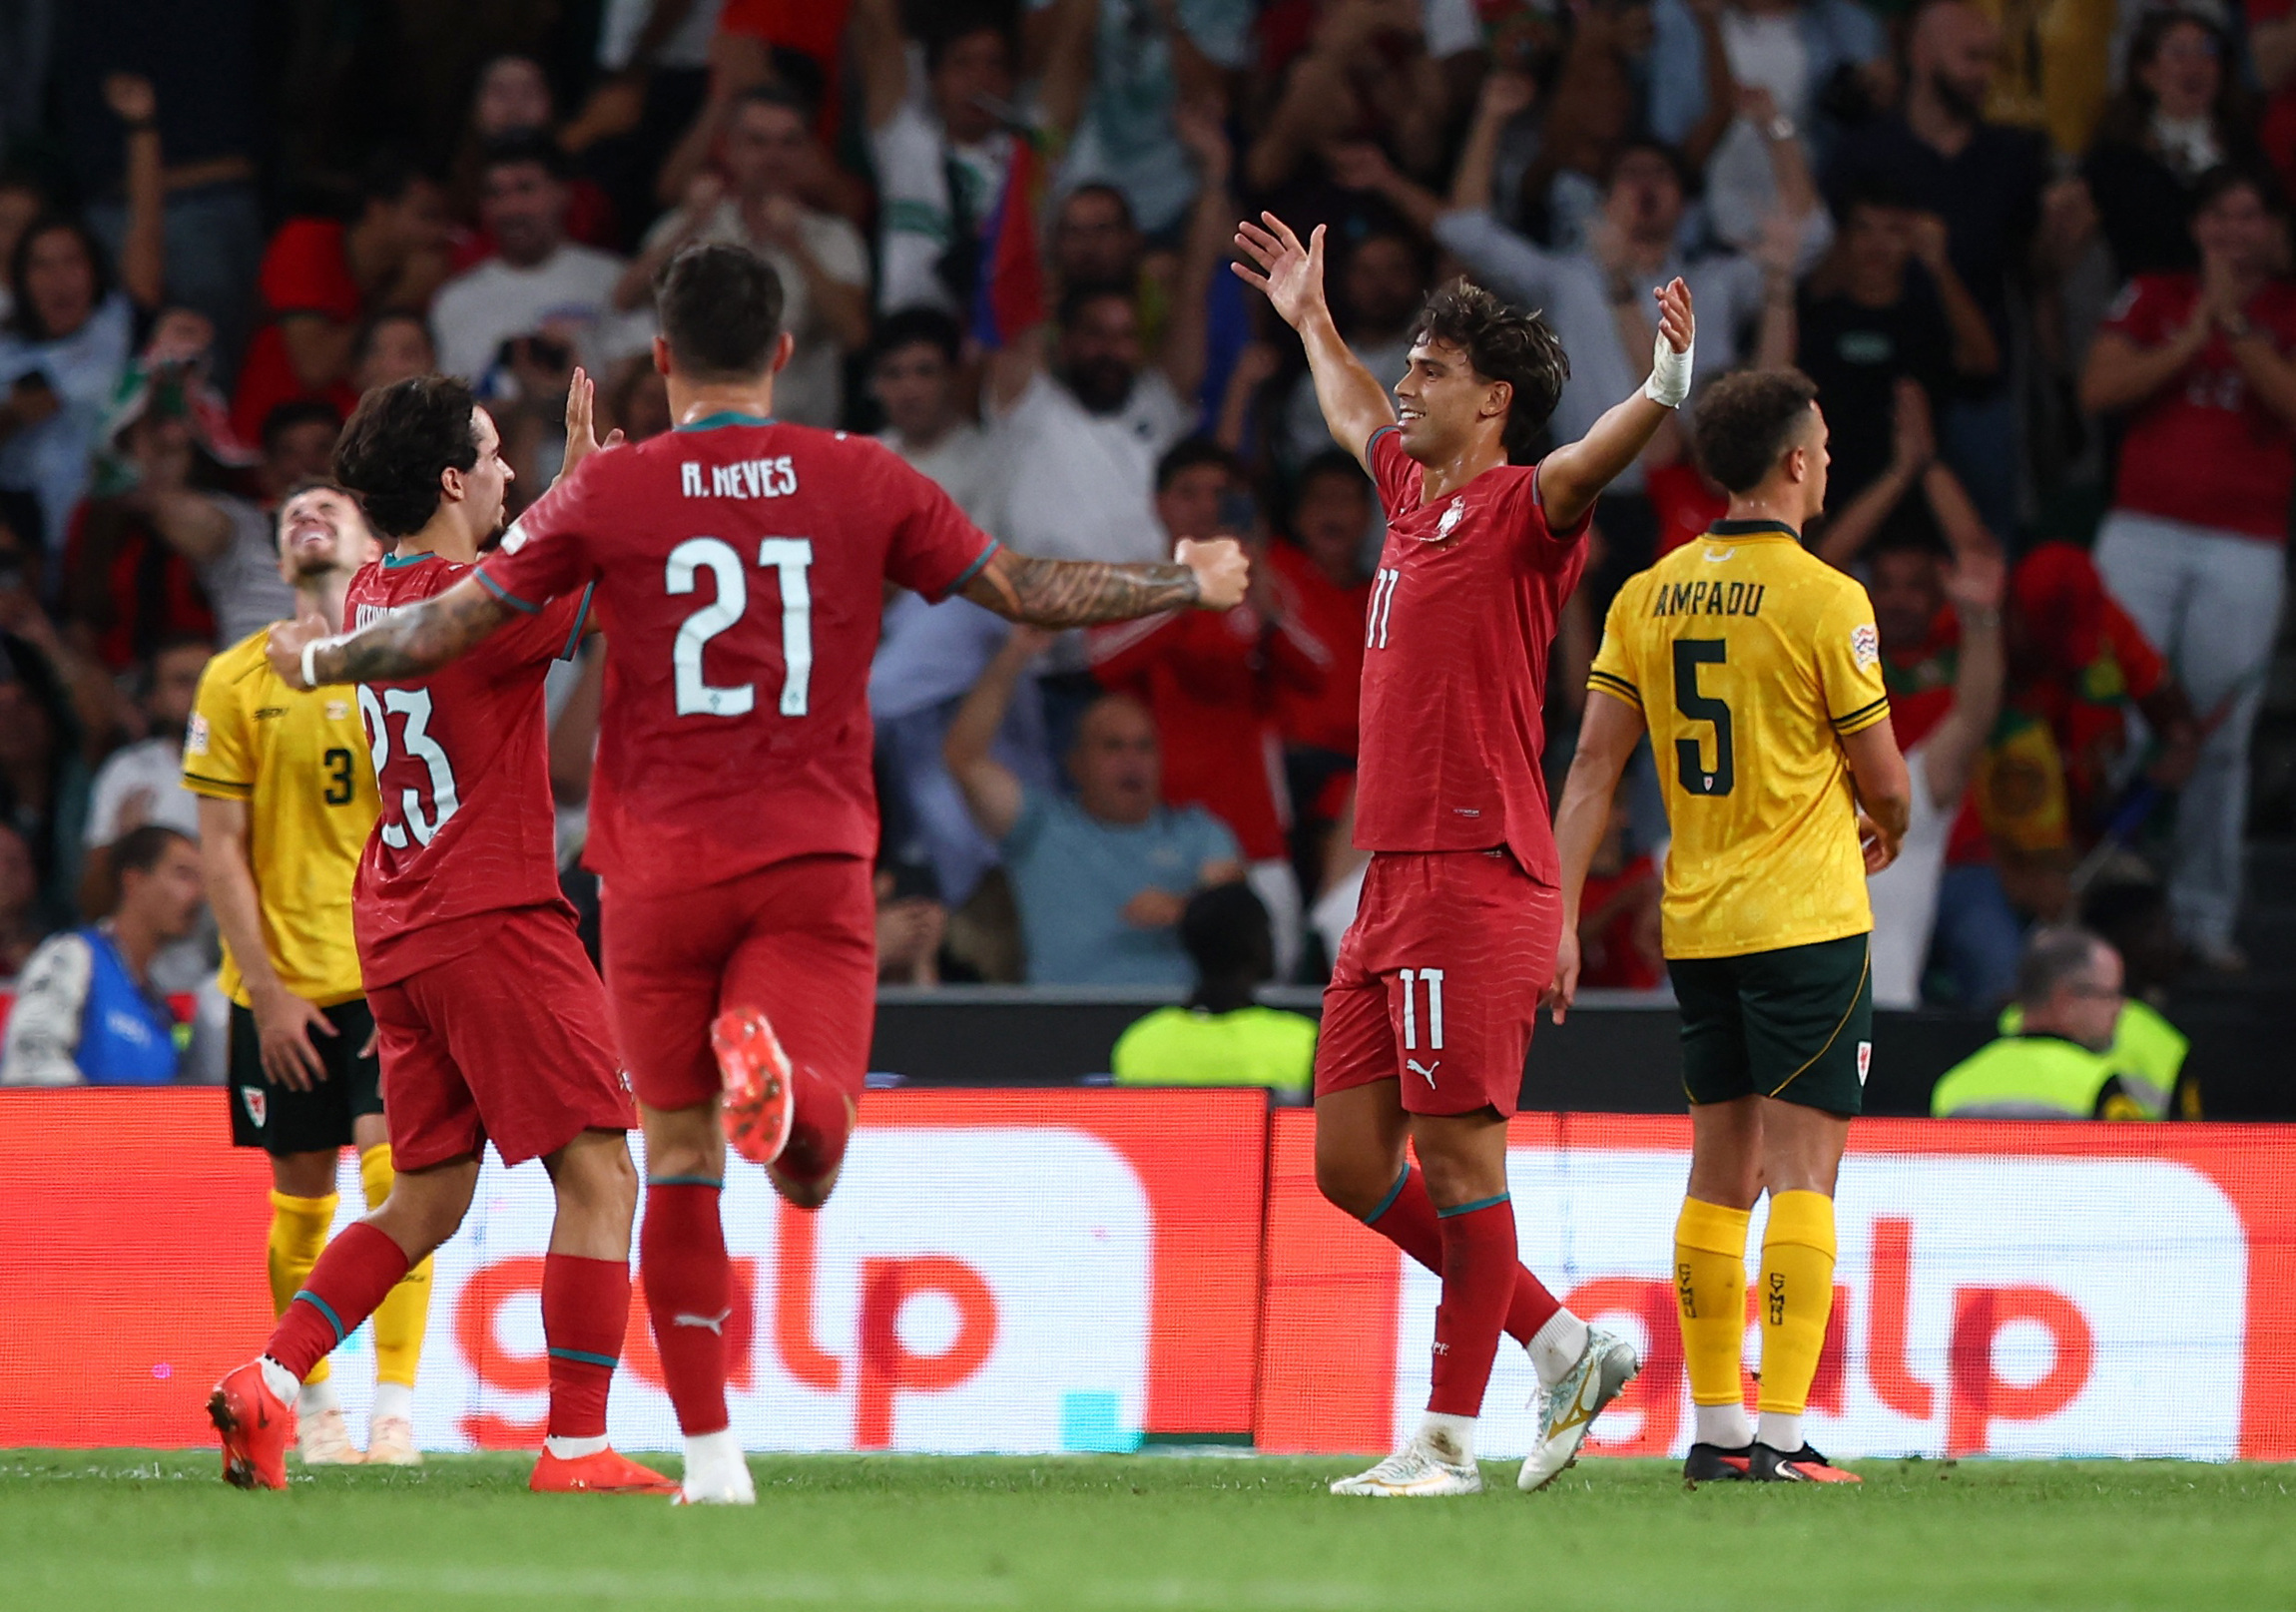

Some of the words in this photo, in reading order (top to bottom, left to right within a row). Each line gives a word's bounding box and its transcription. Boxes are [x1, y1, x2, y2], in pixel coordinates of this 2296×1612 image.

[681, 461, 710, 498] R.
[712, 455, 798, 500] NEVES
[665, 536, 814, 717] 21
[1367, 568, 1400, 650] 11
[1654, 581, 1765, 617] AMPADU
[1672, 638, 1735, 797] 5
[324, 749, 353, 805] 3
[357, 683, 461, 849] 23
[1400, 968, 1443, 1049] 11
[1769, 1271, 1786, 1327] CYMRU
